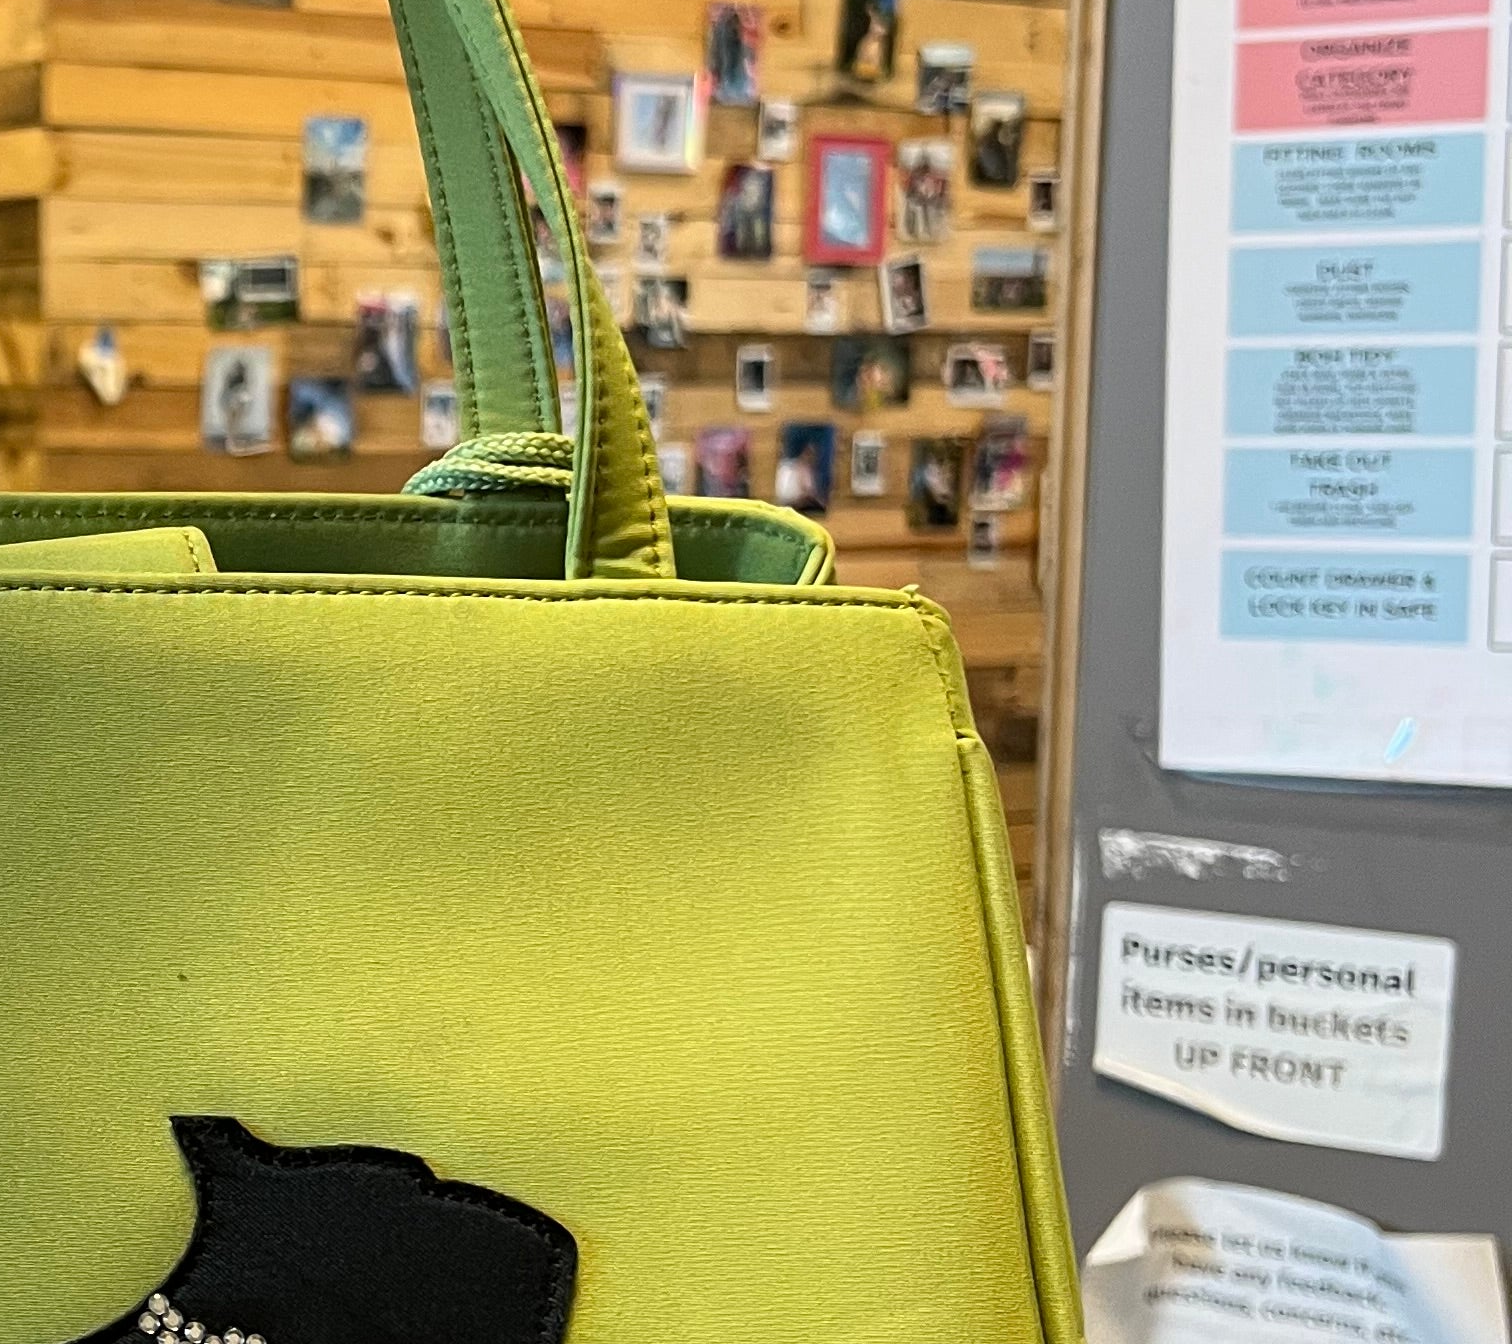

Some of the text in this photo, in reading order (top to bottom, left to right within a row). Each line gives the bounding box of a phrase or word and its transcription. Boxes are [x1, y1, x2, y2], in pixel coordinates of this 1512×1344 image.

[1121, 933, 1416, 998] Purses/personal
[1121, 979, 1412, 1048] items in buckets
[1173, 1040, 1348, 1090] UP FRONT
